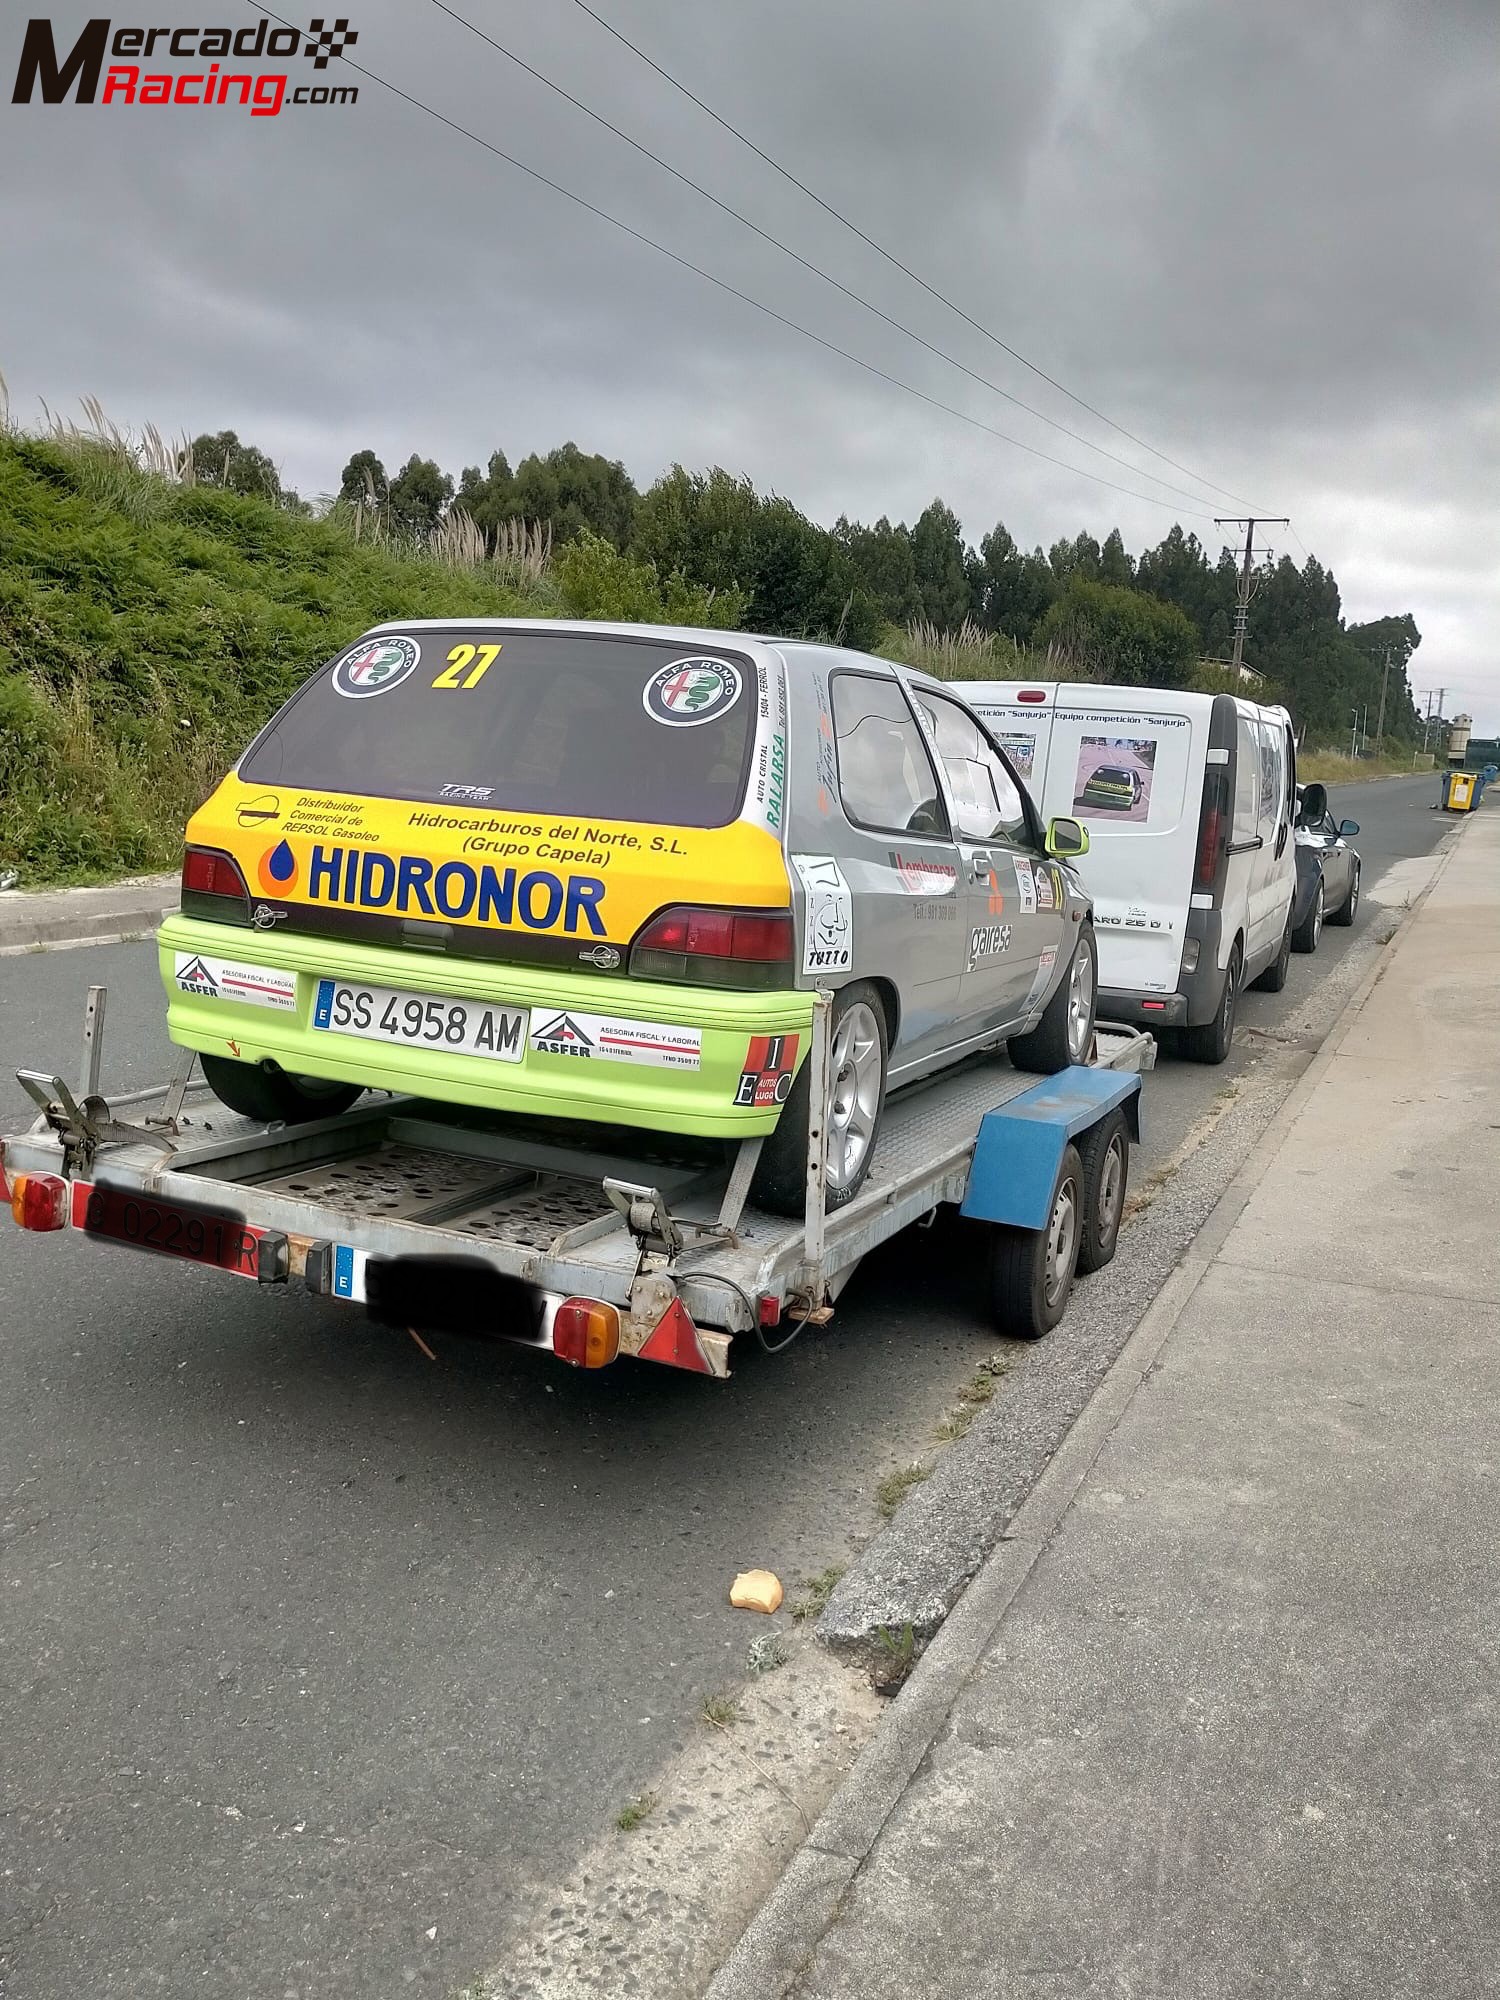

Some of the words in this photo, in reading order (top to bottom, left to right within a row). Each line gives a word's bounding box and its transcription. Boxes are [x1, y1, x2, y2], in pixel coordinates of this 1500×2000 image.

[346, 642, 382, 665] ALFA
[388, 639, 416, 668] ROMEO
[431, 643, 503, 689] 27
[655, 662, 693, 687] ALFA
[700, 661, 735, 696] ROMEO
[758, 667, 769, 693] FERROL
[1055, 712, 1084, 721] Equipo
[1086, 714, 1141, 724] competición
[759, 745, 768, 777] CRISTAL
[442, 783, 497, 796] TRS
[757, 779, 766, 803] AUTO
[766, 735, 785, 829] RALARSA
[296, 797, 365, 813] Distribuidor
[290, 810, 348, 824] Comercial
[347, 816, 363, 826] de
[281, 822, 329, 836] REPSOL
[332, 828, 380, 842] Gasoleo
[408, 812, 543, 837] Hidrocarburos
[549, 824, 578, 841] del
[583, 828, 643, 851] Norte,
[649, 836, 689, 855] S.L.
[462, 836, 530, 856] (Grupo
[536, 843, 611, 869] Capela)
[309, 844, 608, 937] HIDRONOR
[1093, 915, 1122, 925] ARO
[969, 925, 1012, 971] gairesa
[808, 950, 849, 966] TUTTO
[181, 982, 219, 997] ASFER
[271, 979, 294, 989] LABORAL
[319, 1010, 327, 1021] E
[333, 989, 374, 1029] SS
[379, 996, 467, 1044] 4958
[473, 1011, 522, 1054] AM
[600, 1027, 635, 1037] ASESORIA
[635, 1030, 660, 1041] FISCAL
[668, 1036, 701, 1046] LABORAL
[536, 1041, 591, 1058] ASFER
[734, 1074, 758, 1104] E
[774, 1073, 792, 1103] C
[758, 1079, 778, 1088] AUTOS
[755, 1091, 774, 1100] LUGO
[339, 1276, 348, 1289] E
